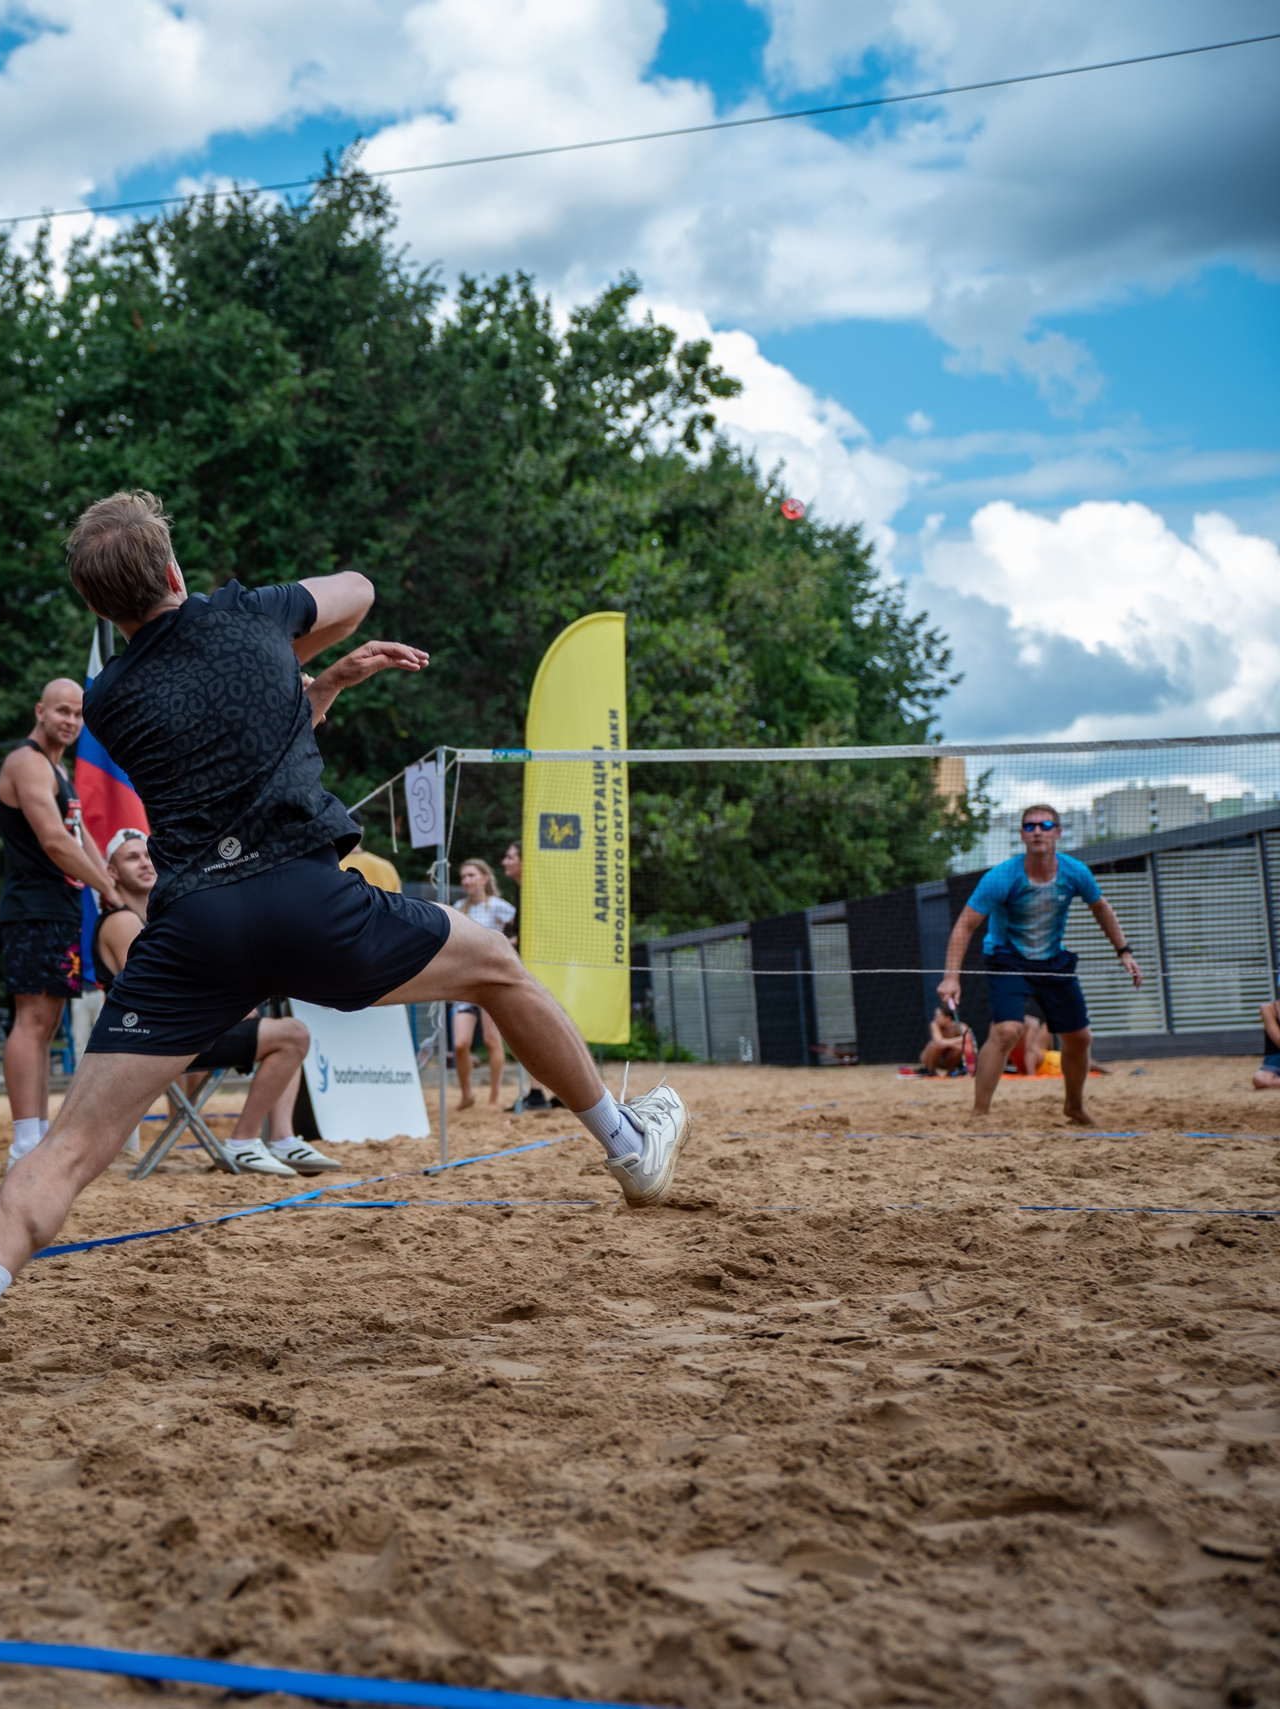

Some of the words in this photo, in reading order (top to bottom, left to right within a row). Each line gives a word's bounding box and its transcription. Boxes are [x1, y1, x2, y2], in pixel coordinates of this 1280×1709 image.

[609, 709, 622, 770] ХМКИ
[412, 776, 436, 834] 3
[613, 777, 624, 842] ОКРУГА
[223, 839, 235, 853] TW
[614, 848, 625, 964] ГОРОДСКОГО
[334, 1066, 414, 1083] badmintonist.com
